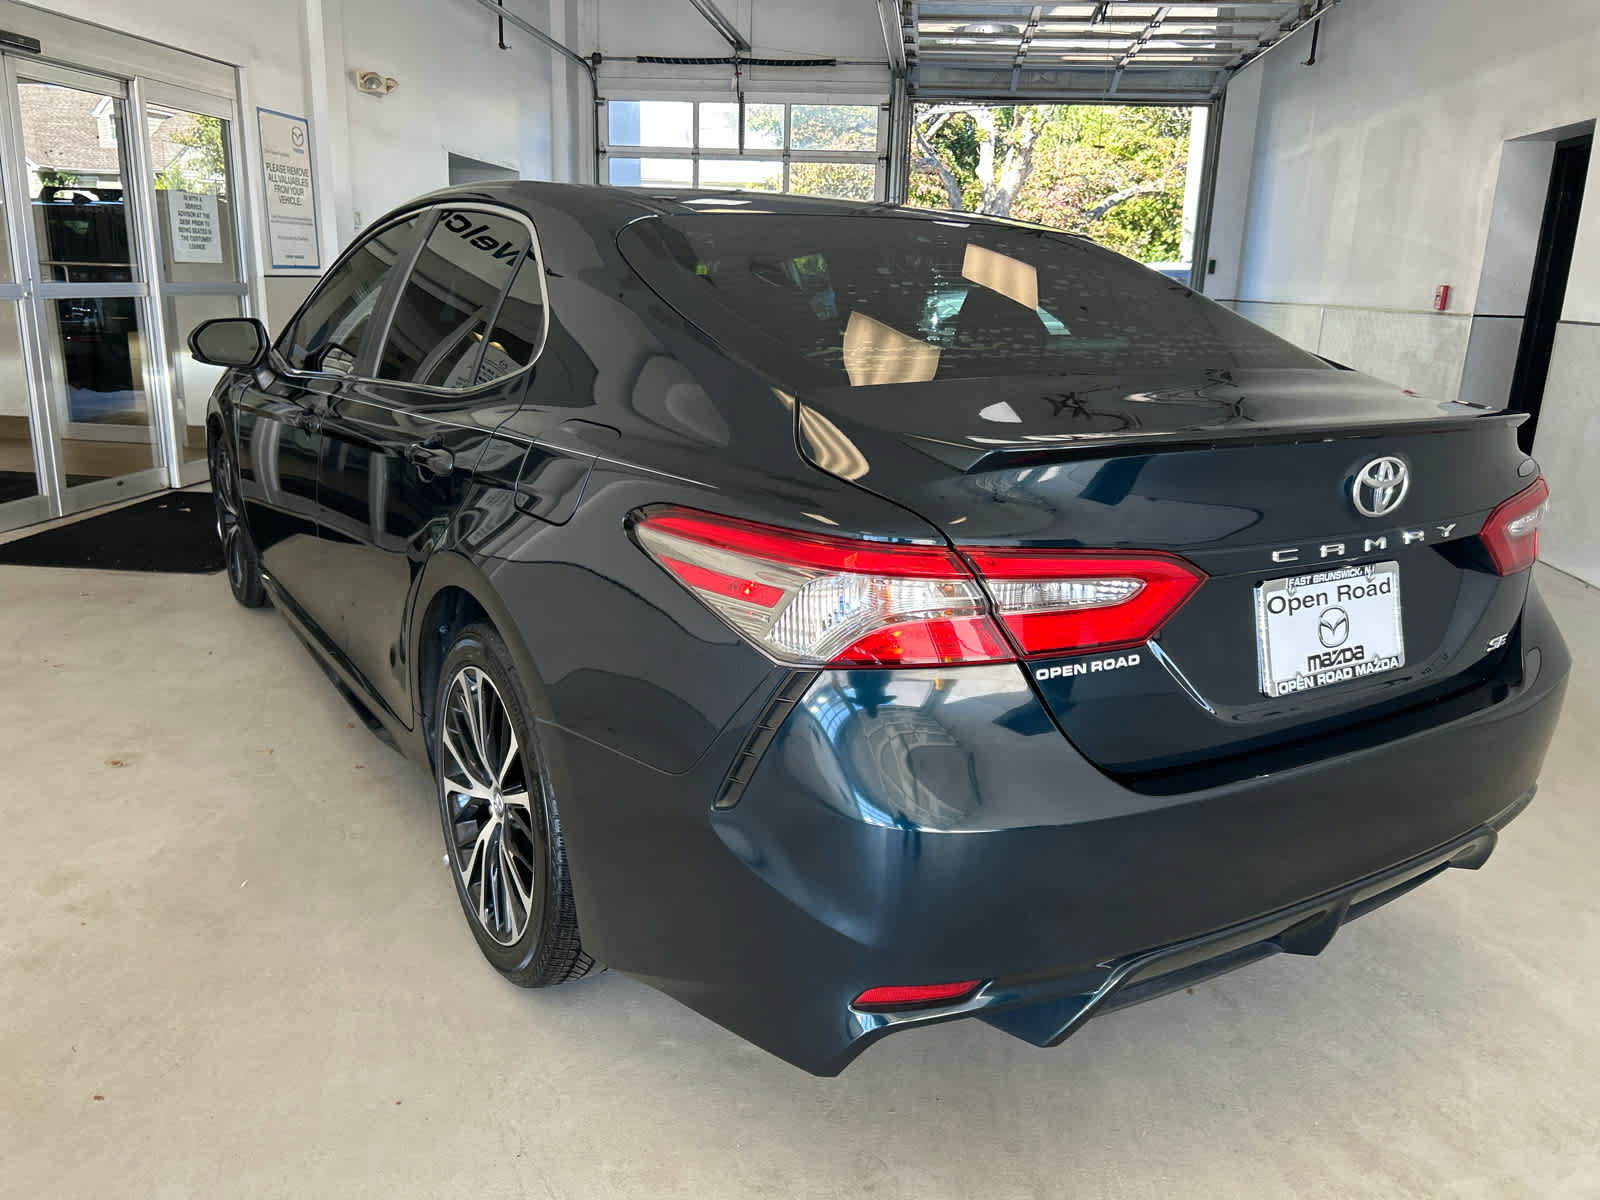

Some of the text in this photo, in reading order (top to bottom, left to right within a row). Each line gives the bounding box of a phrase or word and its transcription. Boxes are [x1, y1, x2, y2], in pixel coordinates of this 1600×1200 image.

[266, 162, 309, 177] PLEASE REMOVE
[268, 173, 309, 188] ALL VALUABLES
[273, 184, 305, 196] FROM YOUR
[1272, 523, 1457, 563] CAMRY
[1267, 577, 1391, 616] Open Road
[1487, 632, 1508, 652] SE
[1035, 654, 1141, 680] OPEN ROAD
[1307, 645, 1365, 672] mazda
[1277, 656, 1399, 695] OPEN ROAD MAZDA
